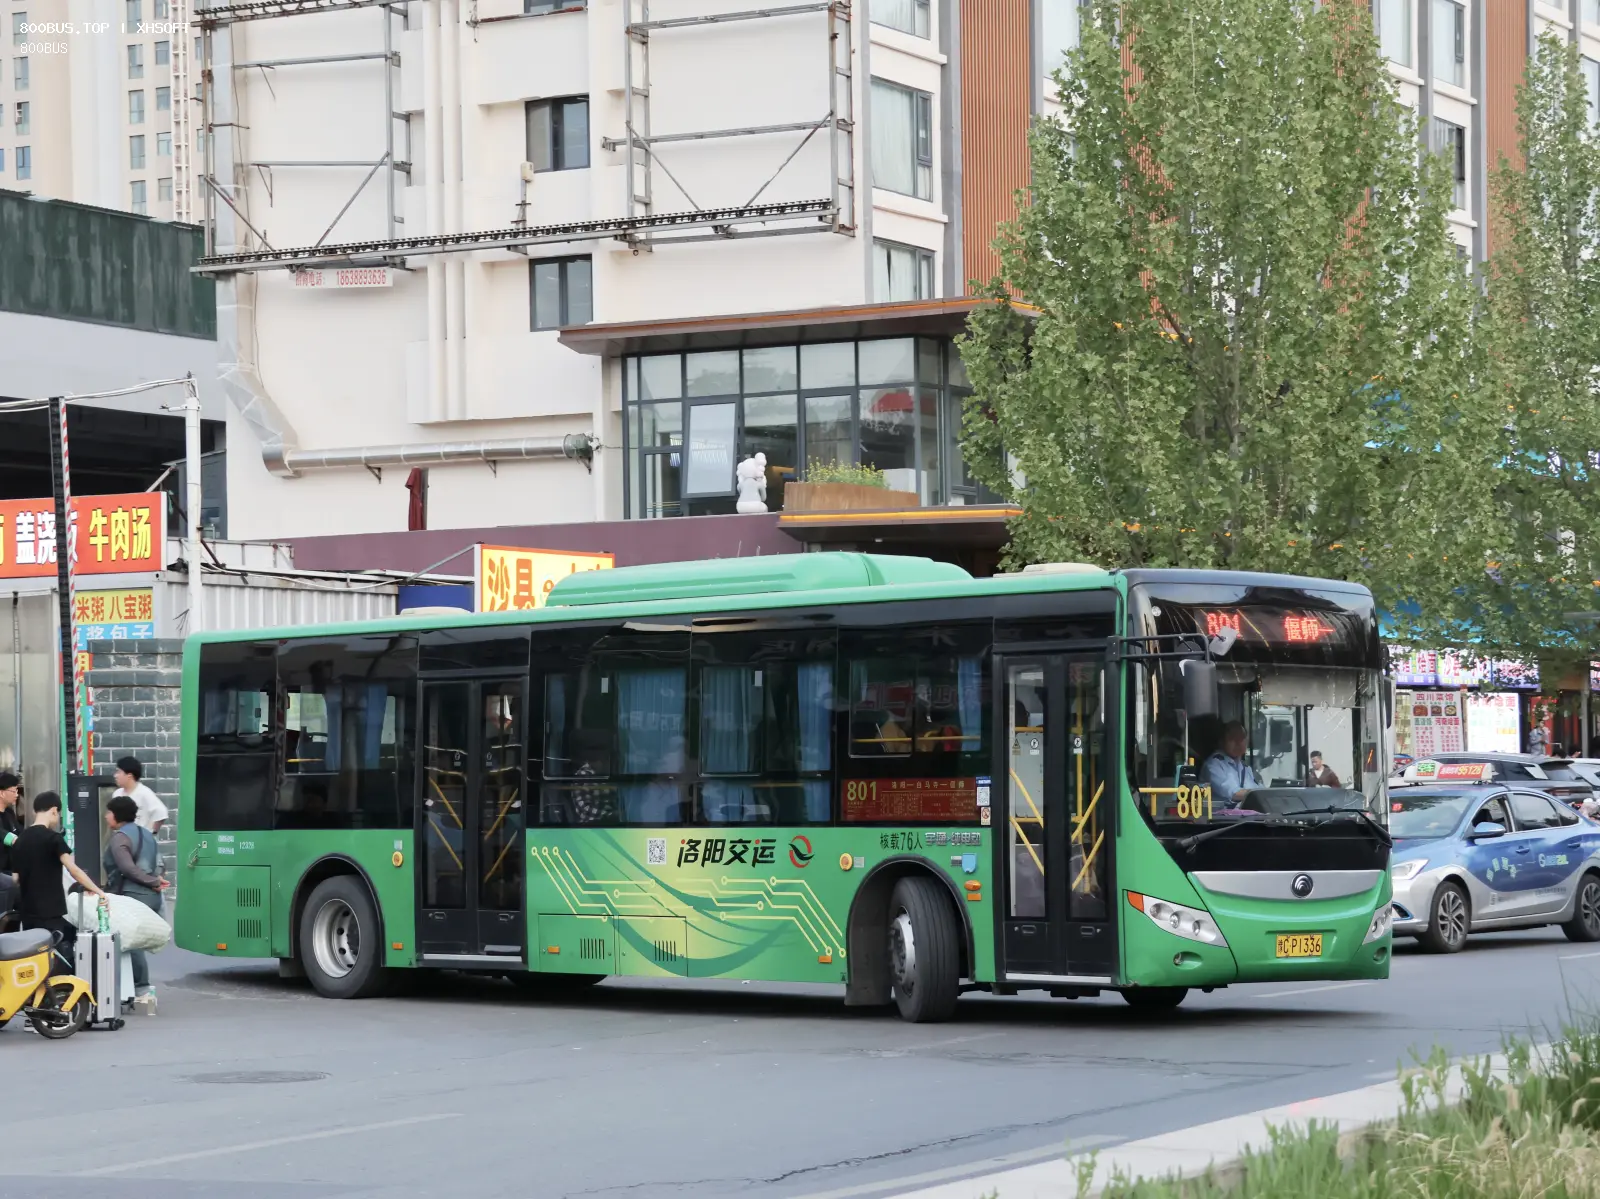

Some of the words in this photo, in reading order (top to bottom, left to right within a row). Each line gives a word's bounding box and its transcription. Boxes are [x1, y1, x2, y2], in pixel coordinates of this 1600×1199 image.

[89, 506, 151, 562] 牛肉汤
[109, 594, 152, 620] 八宝粥
[1207, 612, 1242, 638] 801
[847, 780, 877, 801] 801
[1176, 784, 1213, 820] 801
[676, 838, 777, 868] 洛阳交运
[879, 831, 923, 851] 核载76人
